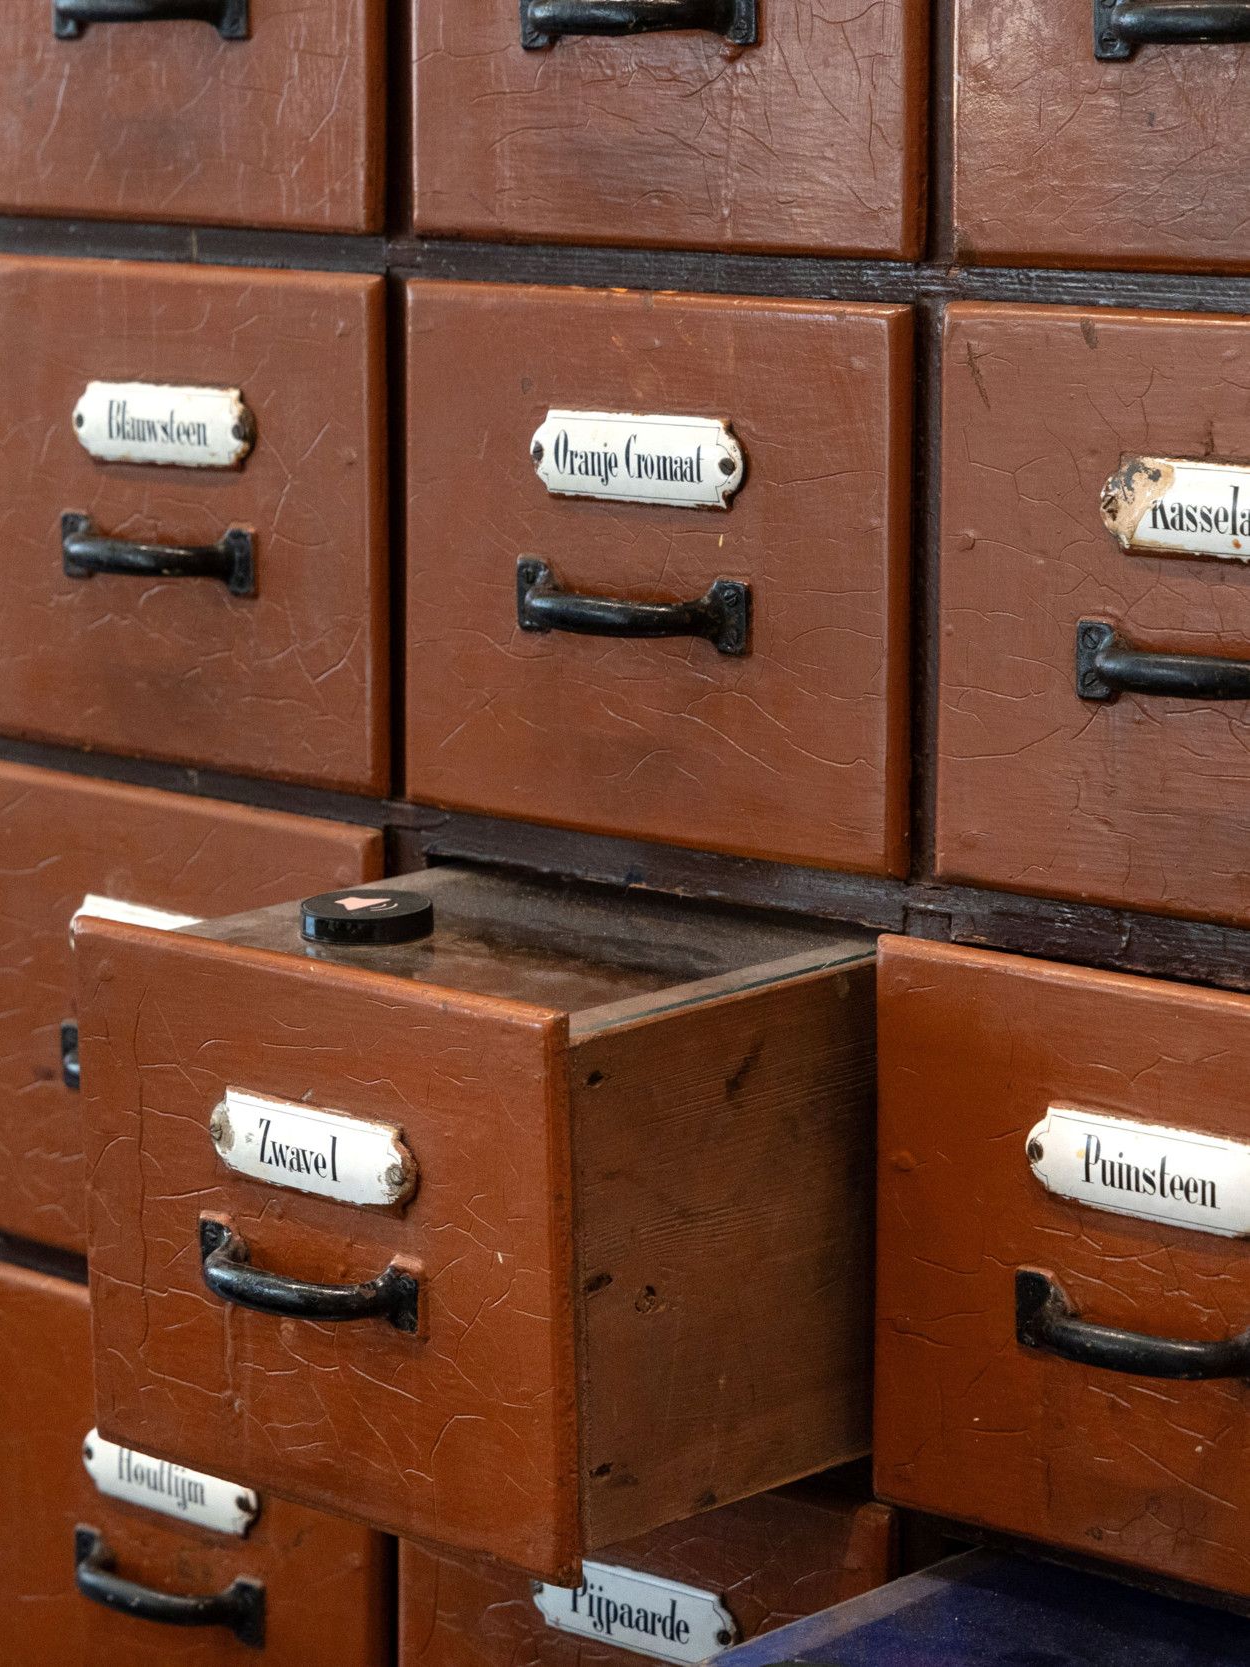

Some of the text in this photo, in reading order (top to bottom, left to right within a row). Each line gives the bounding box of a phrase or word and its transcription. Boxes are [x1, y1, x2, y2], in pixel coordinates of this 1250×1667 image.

[107, 399, 208, 447] Blauwsteen
[554, 429, 704, 486] Oranje Cromaat
[258, 1117, 341, 1183] Zwavel
[1081, 1132, 1221, 1210] Puinsteen
[570, 1575, 690, 1645] Pijpaarde
